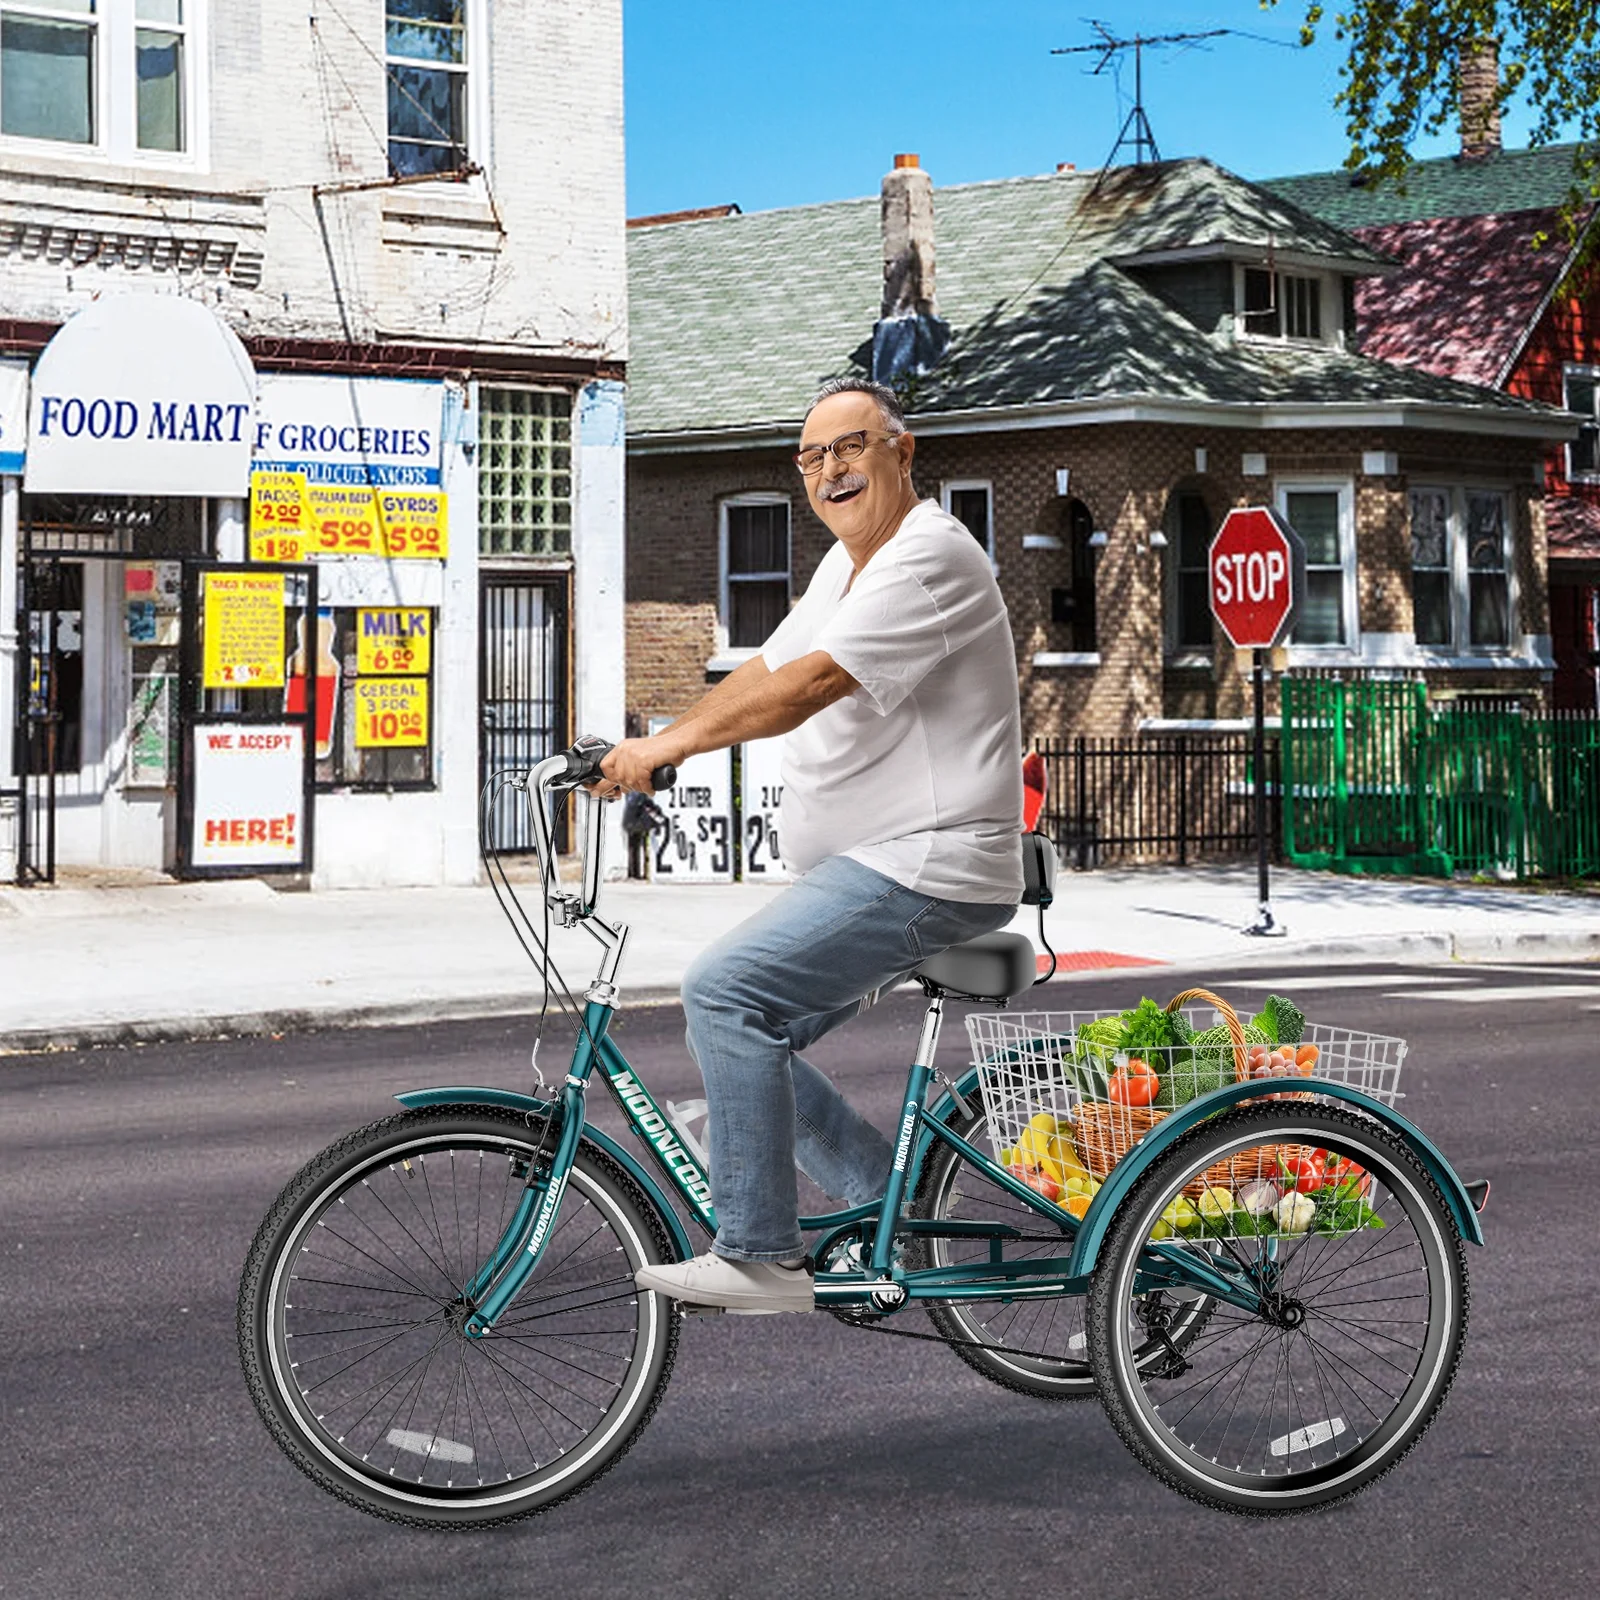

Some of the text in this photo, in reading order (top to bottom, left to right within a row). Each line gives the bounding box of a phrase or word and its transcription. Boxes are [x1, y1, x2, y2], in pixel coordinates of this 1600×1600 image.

[39, 396, 138, 439] FOOD
[147, 402, 249, 442] MART
[279, 424, 431, 457] GROCERIES
[383, 497, 438, 513] GYROS
[1215, 551, 1285, 604] STOP
[364, 612, 426, 637] MILK
[360, 683, 419, 698] CEREAL
[367, 699, 409, 713] 3 FOR
[207, 734, 293, 749] WE ACCEPT
[669, 787, 711, 808] 2 LITER
[205, 813, 296, 846] HERE!
[609, 1070, 714, 1218] MOONCOOL
[893, 1113, 916, 1173] MOONCOOL
[526, 1175, 563, 1256] MOONCOOL
